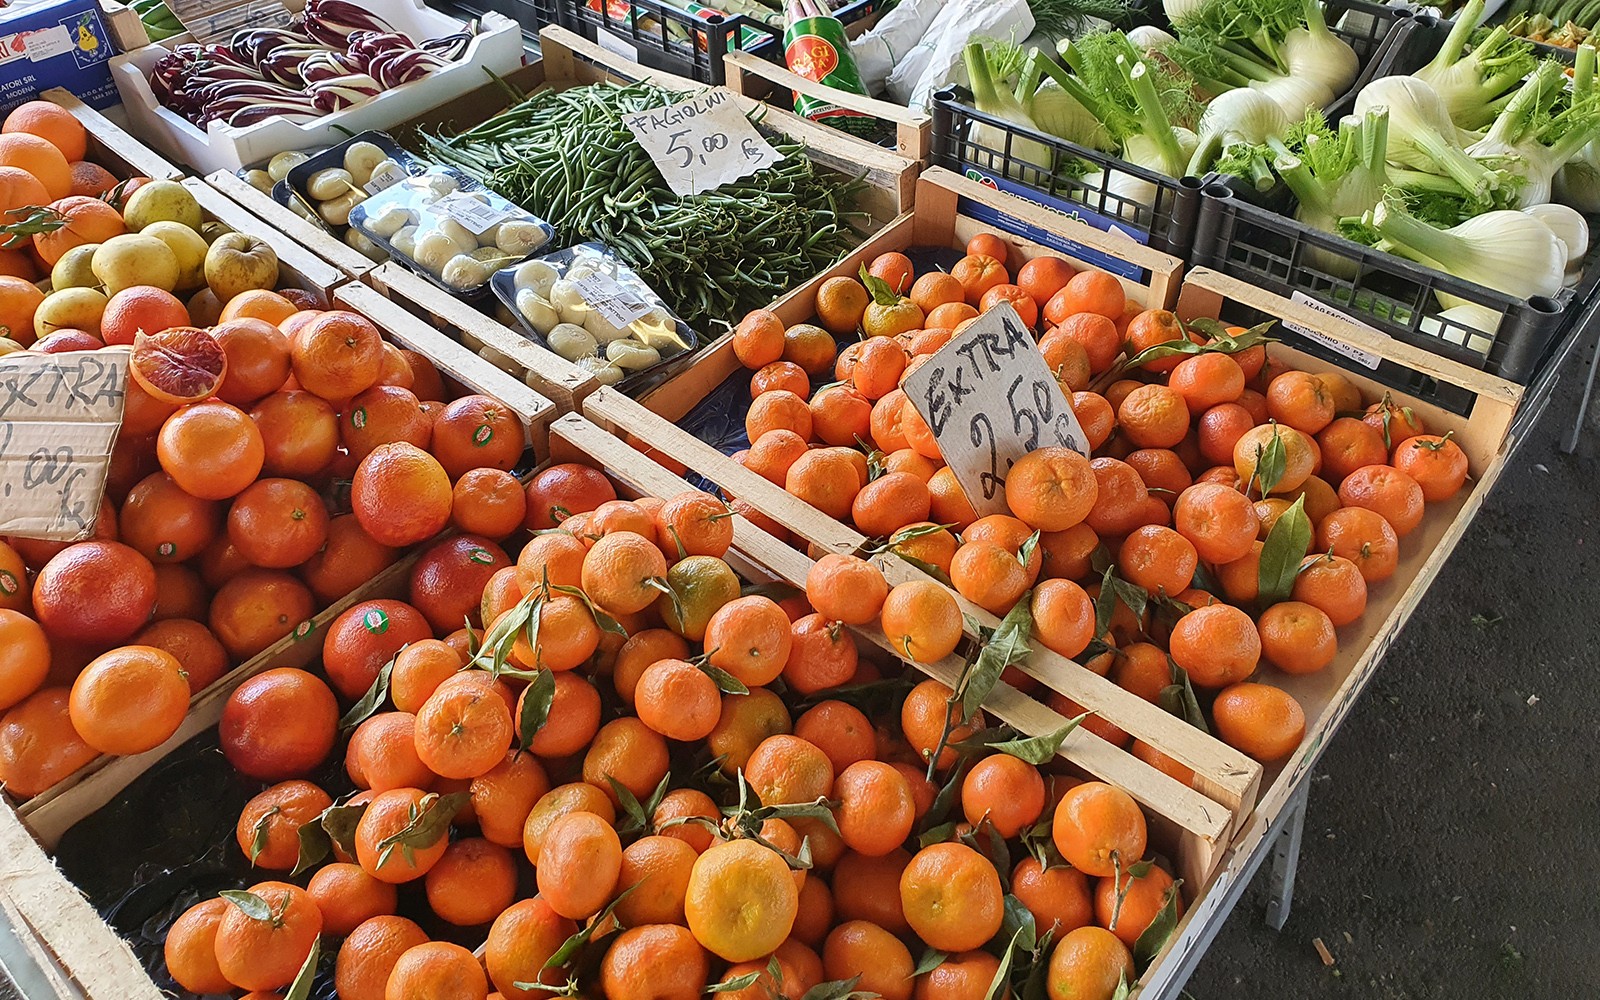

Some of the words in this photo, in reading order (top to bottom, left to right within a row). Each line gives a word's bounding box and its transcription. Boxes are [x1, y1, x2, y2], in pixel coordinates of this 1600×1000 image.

[23, 75, 36, 85] SRL
[5, 85, 36, 100] MODENA
[665, 128, 729, 169] 5,00
